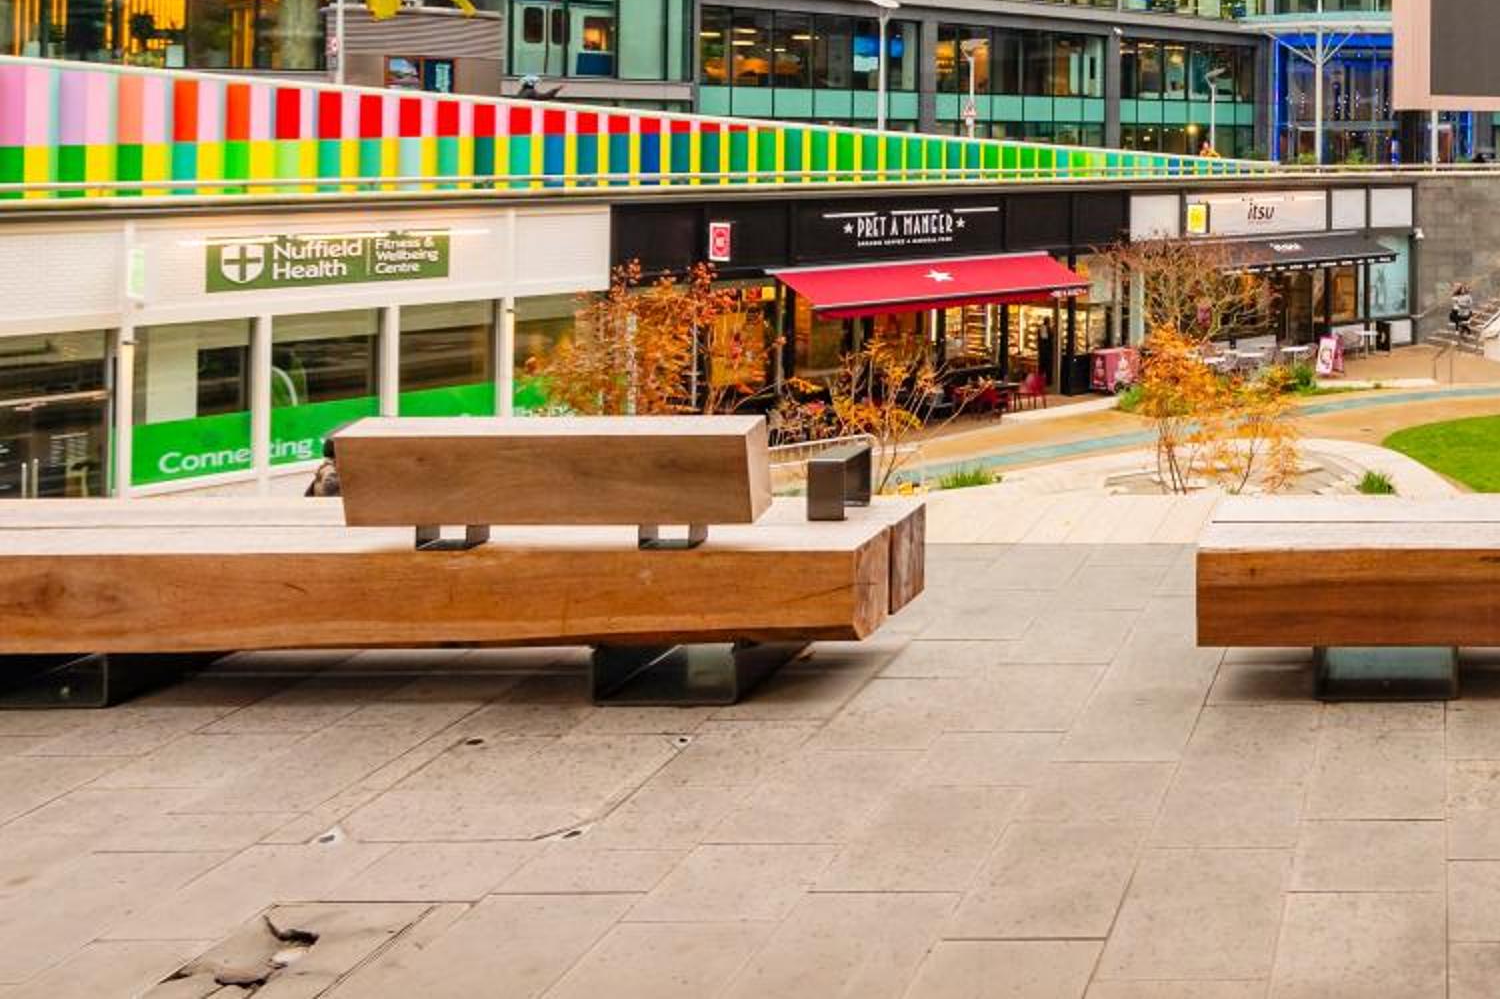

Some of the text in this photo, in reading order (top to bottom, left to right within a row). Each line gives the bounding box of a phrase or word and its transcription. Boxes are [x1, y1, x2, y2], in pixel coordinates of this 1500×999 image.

[1247, 201, 1275, 220] itsu
[857, 212, 953, 239] PRET A MANGER
[272, 238, 363, 260] Nuffield
[375, 237, 421, 250] Fitness
[375, 248, 439, 263] Wellbeing
[272, 259, 347, 281] Health
[375, 261, 420, 274] Centre
[158, 438, 312, 475] Conneting
